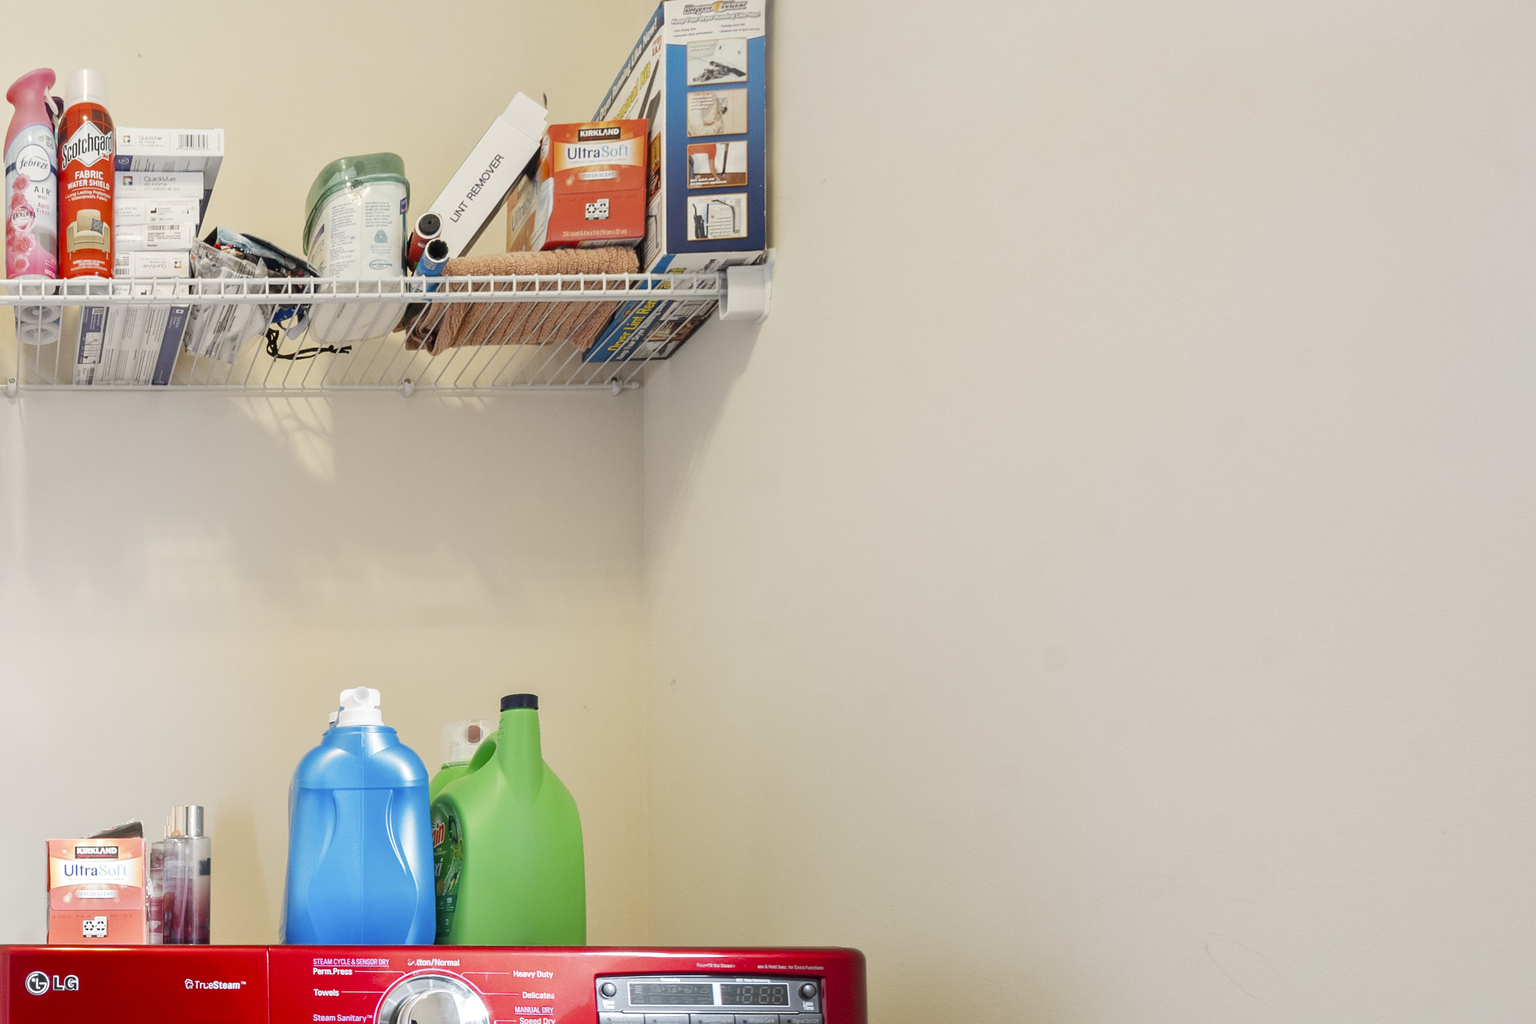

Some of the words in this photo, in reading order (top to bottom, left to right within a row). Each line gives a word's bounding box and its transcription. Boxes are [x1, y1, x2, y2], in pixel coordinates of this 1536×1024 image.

[579, 127, 620, 137] KIRKLAND
[62, 132, 112, 169] Scotchgard
[567, 144, 630, 160] UltraSoft
[19, 156, 48, 170] febreze
[74, 170, 104, 180] FABRIC
[67, 180, 88, 190] WATER
[88, 180, 110, 190] SHIELD
[450, 200, 468, 223] LINT
[466, 154, 504, 201] REMOVER
[34, 186, 50, 196] AIR
[13, 211, 36, 220] Downy
[37, 208, 50, 216] Fresh
[64, 864, 127, 877] UltraSoft
[313, 968, 353, 976] Perm.Press
[513, 970, 535, 979] Heavy
[537, 970, 553, 979] Duty
[52, 975, 79, 992] LG
[314, 989, 340, 997] Towels
[522, 991, 555, 999] Delicates
[313, 1014, 336, 1022] Steam
